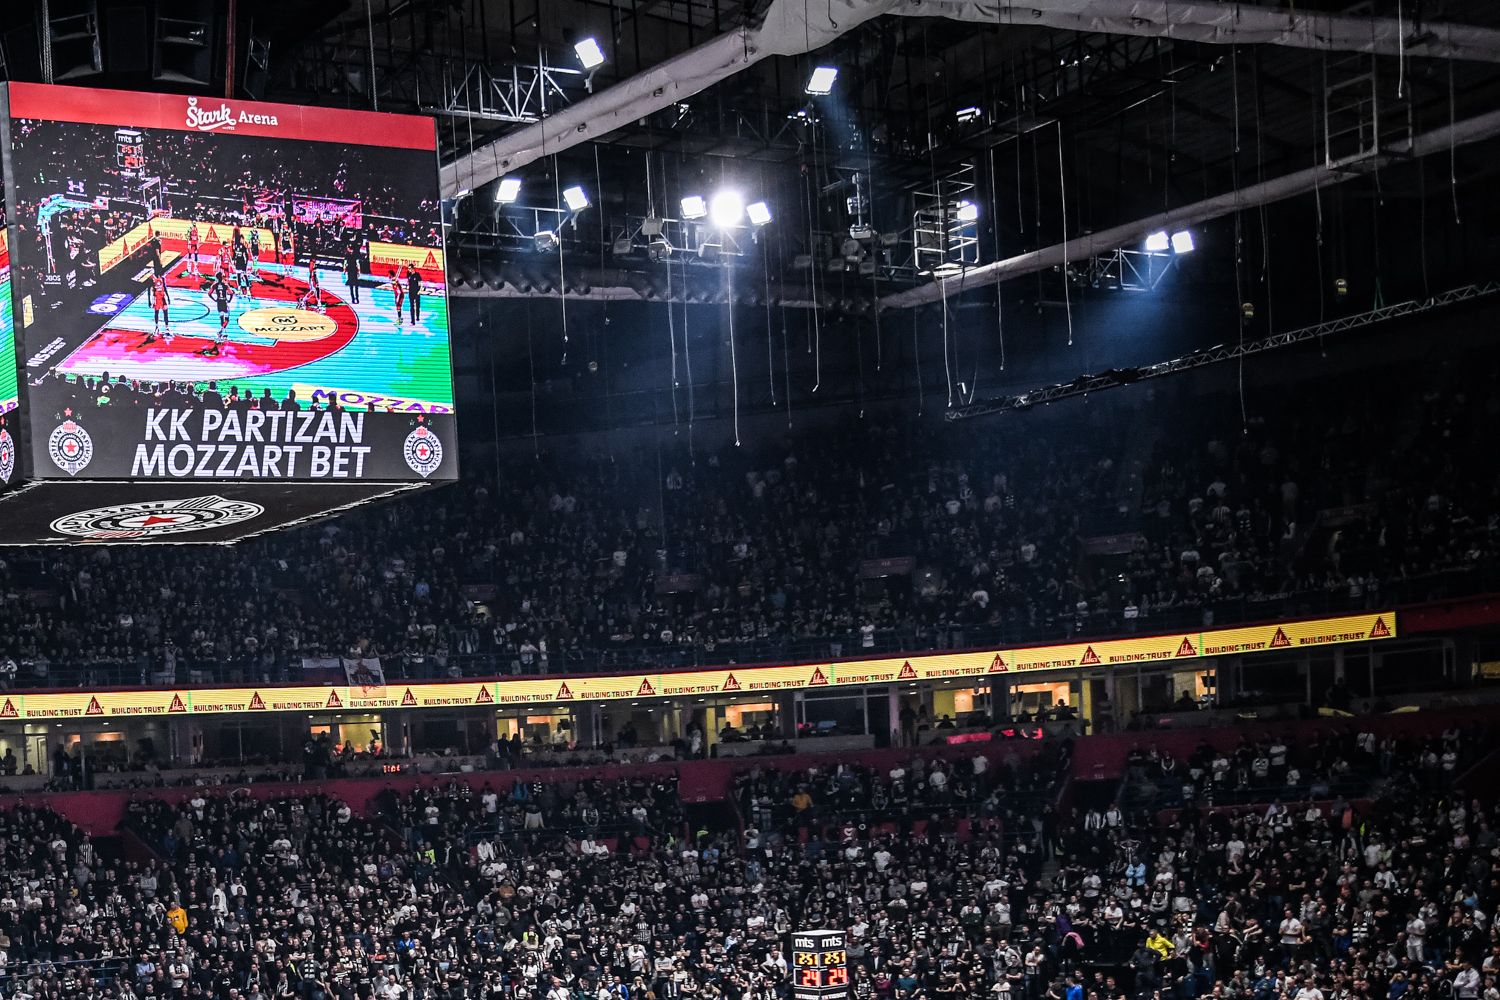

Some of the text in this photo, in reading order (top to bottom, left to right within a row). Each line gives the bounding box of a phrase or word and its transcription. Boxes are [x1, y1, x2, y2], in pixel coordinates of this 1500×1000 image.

[238, 110, 279, 126] Arena
[255, 324, 327, 334] MOZZART
[144, 408, 365, 444] KK PARTIZAN
[131, 444, 371, 478] MOZZART BET
[1300, 632, 1365, 646] BUILDING TRUST
[1110, 651, 1171, 664] BUILDING TRUST
[837, 673, 894, 684] BUILDING TRUST
[581, 689, 633, 699] BUILDING TRUST
[350, 699, 377, 707] BUILDING
[112, 706, 165, 715] BUILDING TRUST
[795, 935, 842, 948] mts mts
[802, 968, 848, 986] 24 24
